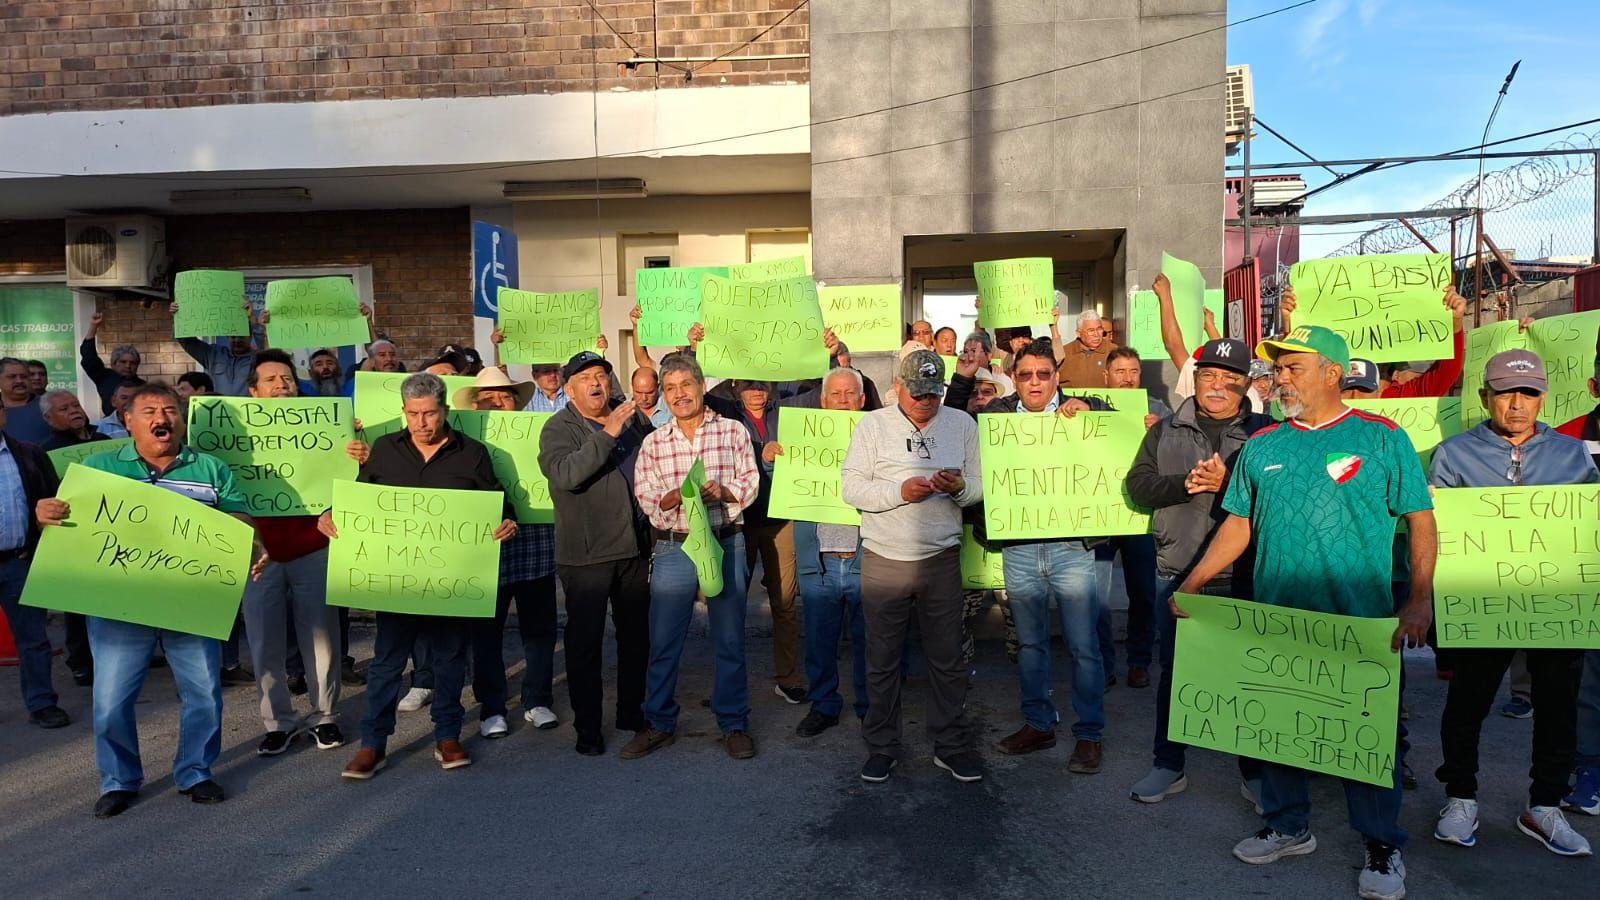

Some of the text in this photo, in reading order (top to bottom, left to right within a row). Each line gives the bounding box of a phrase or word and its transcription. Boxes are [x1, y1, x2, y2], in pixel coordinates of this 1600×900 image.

[637, 270, 698, 292] NO MAS
[703, 278, 816, 309] QUEREMOS
[500, 289, 597, 314] CONFIAMOS
[829, 296, 852, 311] NO
[1332, 291, 1406, 321] DE
[22, 322, 74, 333] TRABAJO?
[502, 311, 596, 335] EN USTED
[703, 313, 820, 345] NUESTROS
[703, 343, 784, 372] PAGOS
[240, 402, 341, 427] BASTA!
[480, 414, 540, 441] BAST
[803, 414, 835, 438] NO
[196, 430, 334, 452] QUEREMOS
[987, 414, 1112, 447] BASTA DE
[793, 478, 839, 498] SIN
[377, 489, 447, 516] CERO
[94, 493, 235, 554] NO MAS
[337, 510, 496, 545] TOLERANCIA
[355, 541, 447, 568] A MAS
[1437, 530, 1486, 556] EN
[1508, 528, 1547, 554] LA
[348, 567, 485, 600] RETRASOS
[1496, 561, 1560, 588] POR
[1217, 603, 1362, 654] JUSTICIA
[1444, 623, 1481, 641] DE
[1178, 683, 1380, 750] COMO DIJO
[1182, 713, 1216, 742] LA
